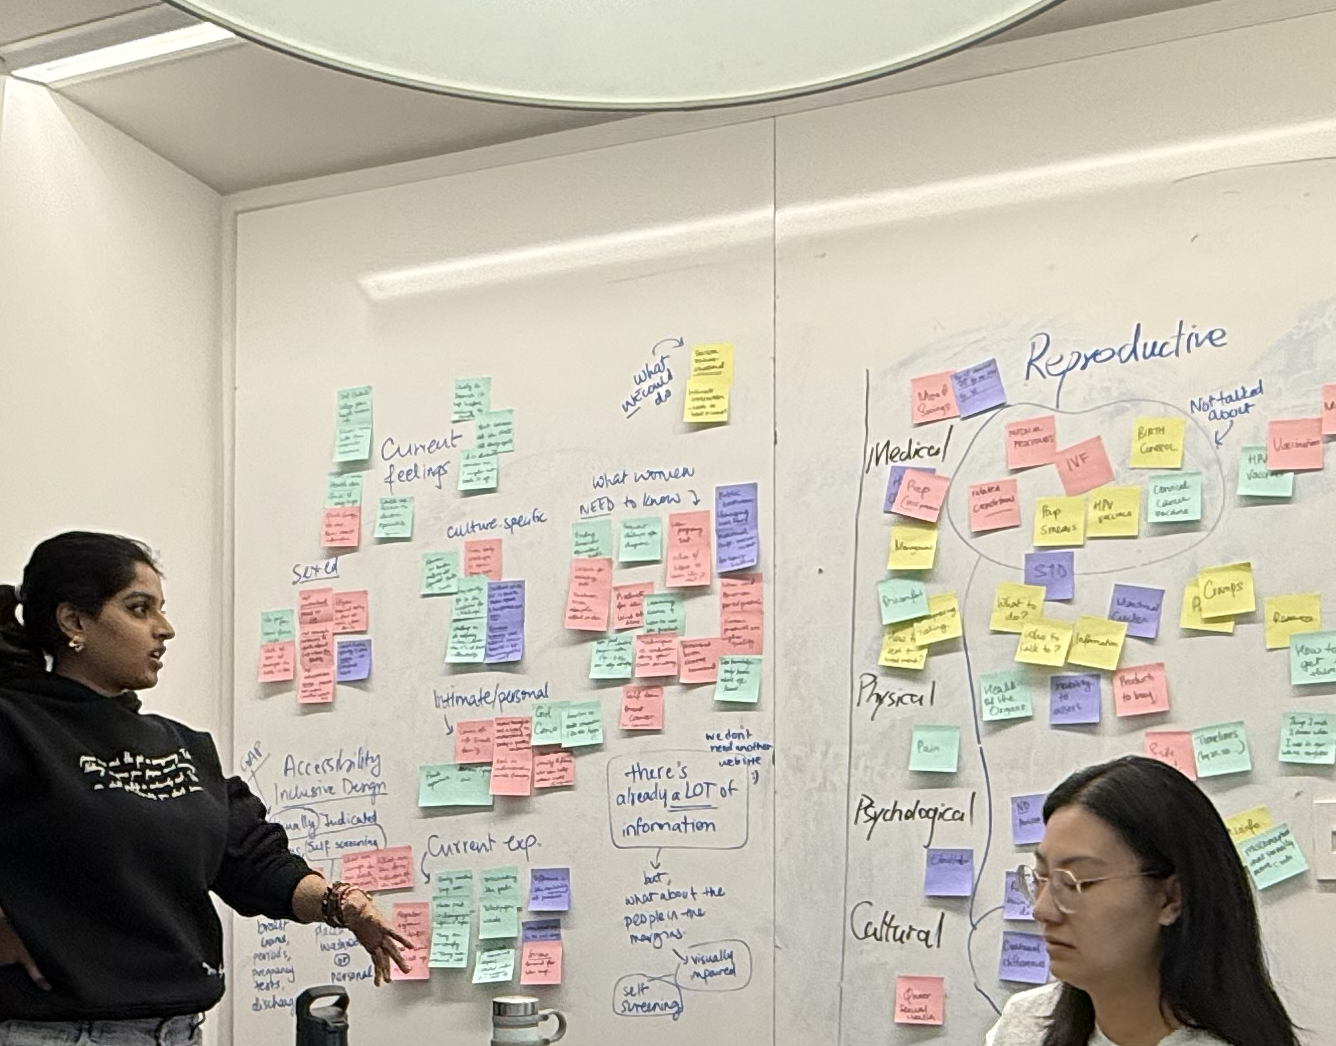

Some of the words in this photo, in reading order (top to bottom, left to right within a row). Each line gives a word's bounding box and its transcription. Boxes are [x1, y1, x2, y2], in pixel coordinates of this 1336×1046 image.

[1025, 320, 1228, 409] Reproductive
[381, 429, 463, 460] Current
[865, 424, 953, 474] Medical
[1066, 452, 1089, 472] IVF
[383, 461, 452, 497] feelings
[634, 466, 695, 483] women
[579, 495, 614, 515] NEED
[623, 494, 637, 509] to
[1093, 500, 1114, 511] HPV
[856, 672, 936, 721] Physical
[706, 732, 723, 741] we
[283, 747, 381, 778] Accessibility
[625, 761, 688, 783] there's
[275, 780, 336, 805] Inclusive
[342, 778, 387, 805] Design
[616, 782, 668, 808] already
[671, 791, 681, 801] a
[685, 781, 717, 799] LOT
[720, 779, 738, 798] of
[622, 816, 716, 837] information
[854, 791, 976, 848] Psychological
[427, 833, 497, 858] Current
[505, 834, 542, 862] exp.
[625, 893, 658, 905] what
[660, 886, 697, 901] about
[702, 886, 725, 897] the
[624, 911, 665, 930] people
[667, 912, 678, 922] in
[680, 907, 706, 918] the
[851, 900, 945, 949] Cultural
[691, 949, 734, 966] visually
[623, 982, 649, 997] self
[621, 1000, 683, 1021] screening
